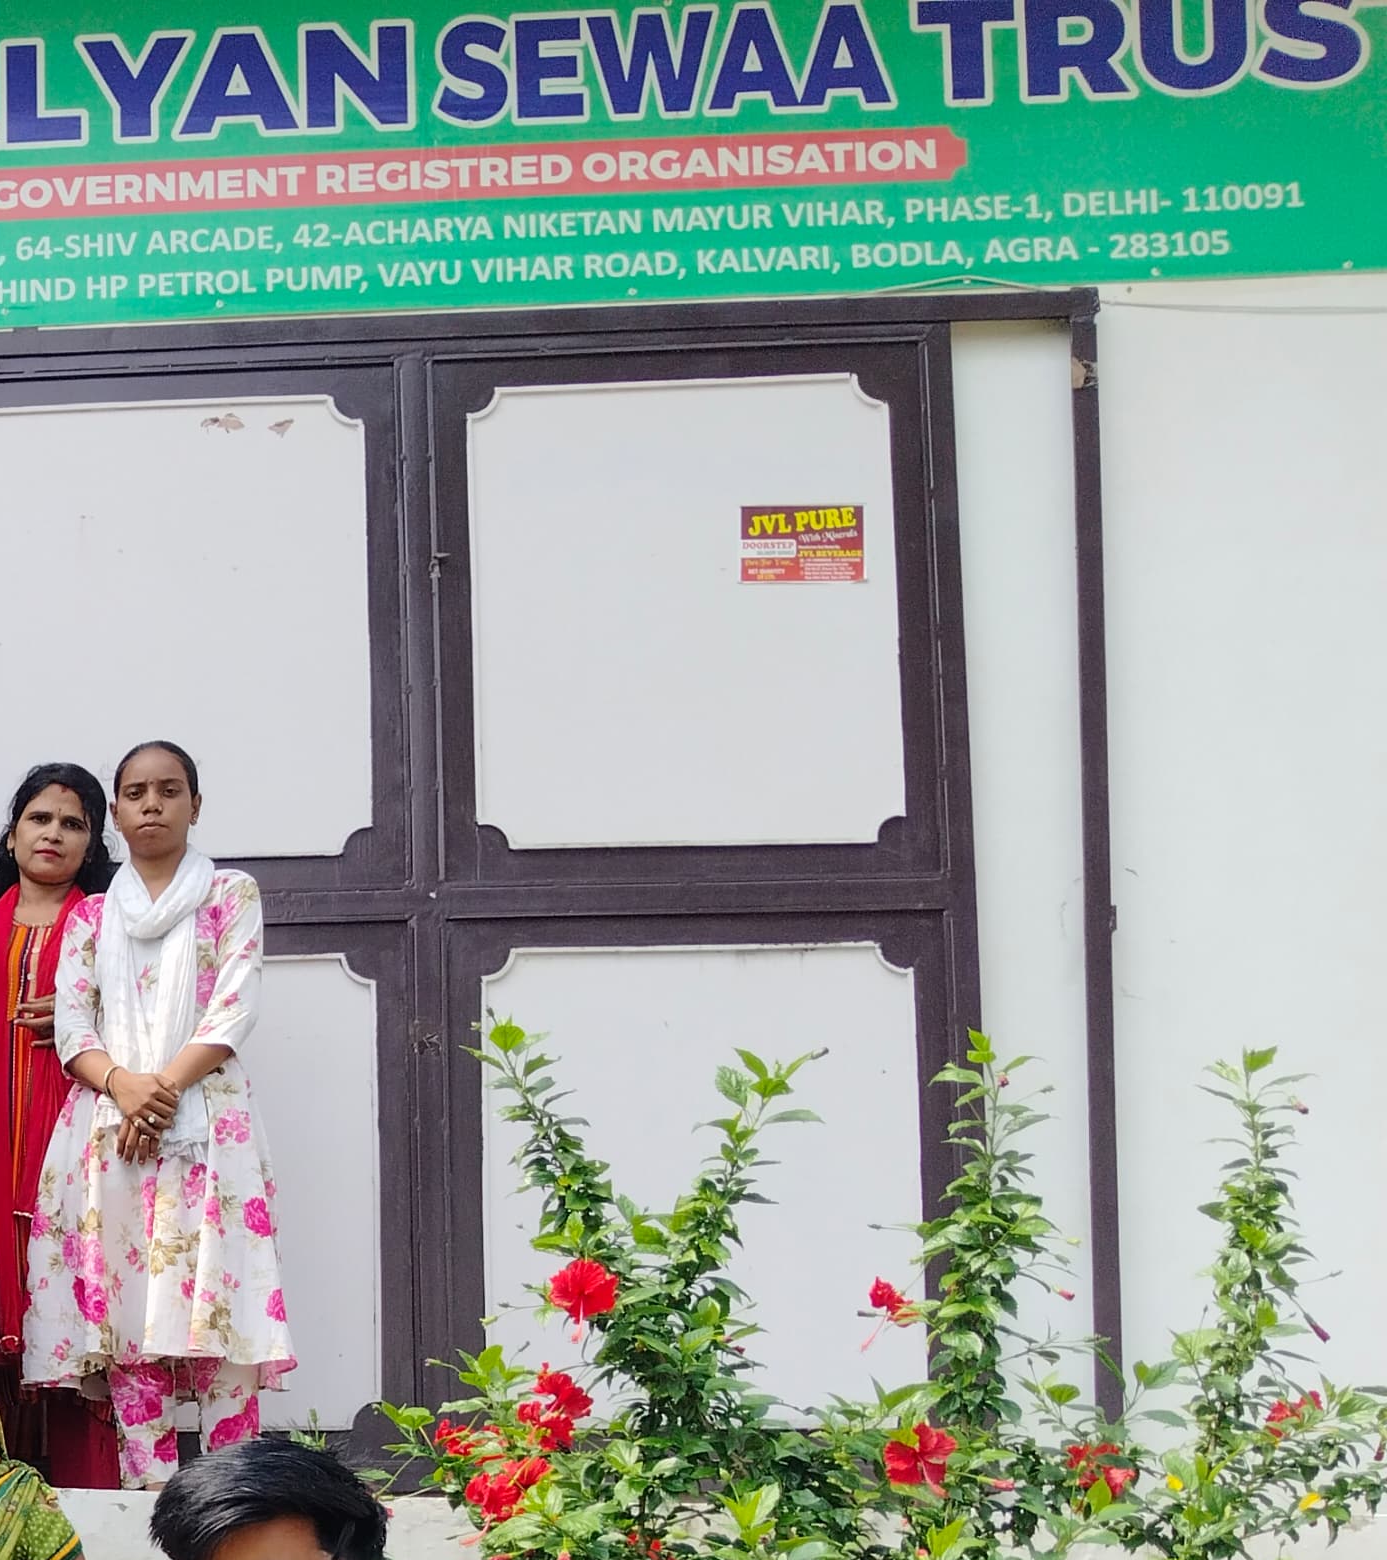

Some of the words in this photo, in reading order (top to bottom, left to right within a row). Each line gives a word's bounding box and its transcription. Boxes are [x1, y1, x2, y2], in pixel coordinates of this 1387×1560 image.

[432, 1, 897, 127] SEWAA
[912, 0, 1377, 107] TRUS
[316, 153, 573, 196] REGISTRED
[582, 139, 937, 182] ORGANISATION
[16, 232, 137, 260] 64-SHIV
[146, 226, 283, 255] ARCADE,
[292, 215, 493, 249] 42-ACHARYA
[504, 210, 641, 239] NIKETAN
[653, 205, 772, 233] MAYUR
[782, 199, 895, 228] VIHAR,
[905, 195, 1053, 224] PHASE-1,
[1063, 190, 1171, 219] DELHI-
[1182, 182, 1304, 212] 110091
[87, 275, 127, 300] HP
[138, 269, 256, 298] PETROL
[267, 264, 367, 293] PUMP,
[378, 260, 461, 287] VAYU
[472, 255, 574, 282] VIHAR
[585, 250, 685, 280] ROAD,
[697, 245, 840, 274] KALVARI,
[852, 240, 974, 269] BODLA,
[984, 235, 1079, 263] AGRA
[1109, 230, 1229, 259] 283105
[748, 514, 792, 536] JVL
[794, 507, 856, 531] PURE
